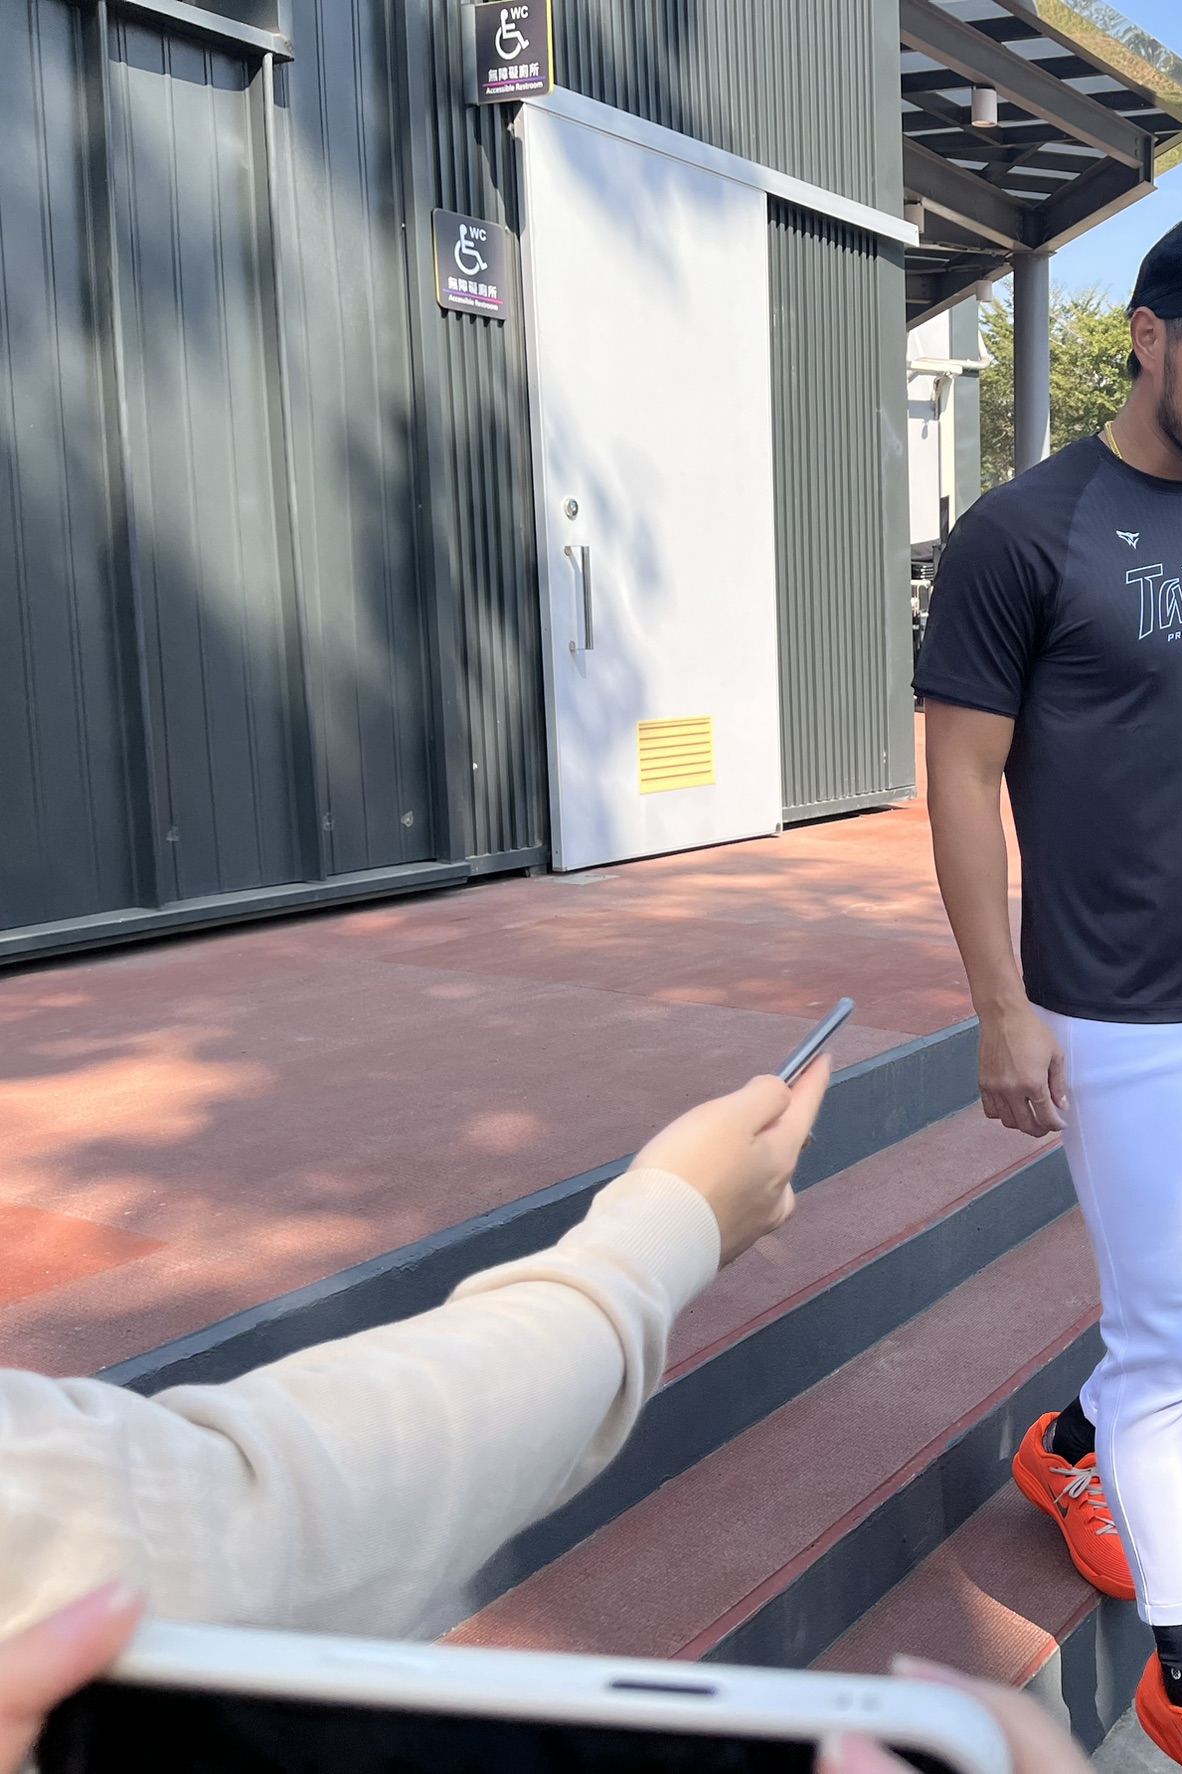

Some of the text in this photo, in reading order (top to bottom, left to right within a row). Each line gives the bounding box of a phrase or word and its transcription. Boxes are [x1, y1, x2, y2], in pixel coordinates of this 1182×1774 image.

[510, 5, 529, 20] WC
[486, 81, 543, 95] Accessible Restroom
[469, 226, 487, 242] WC
